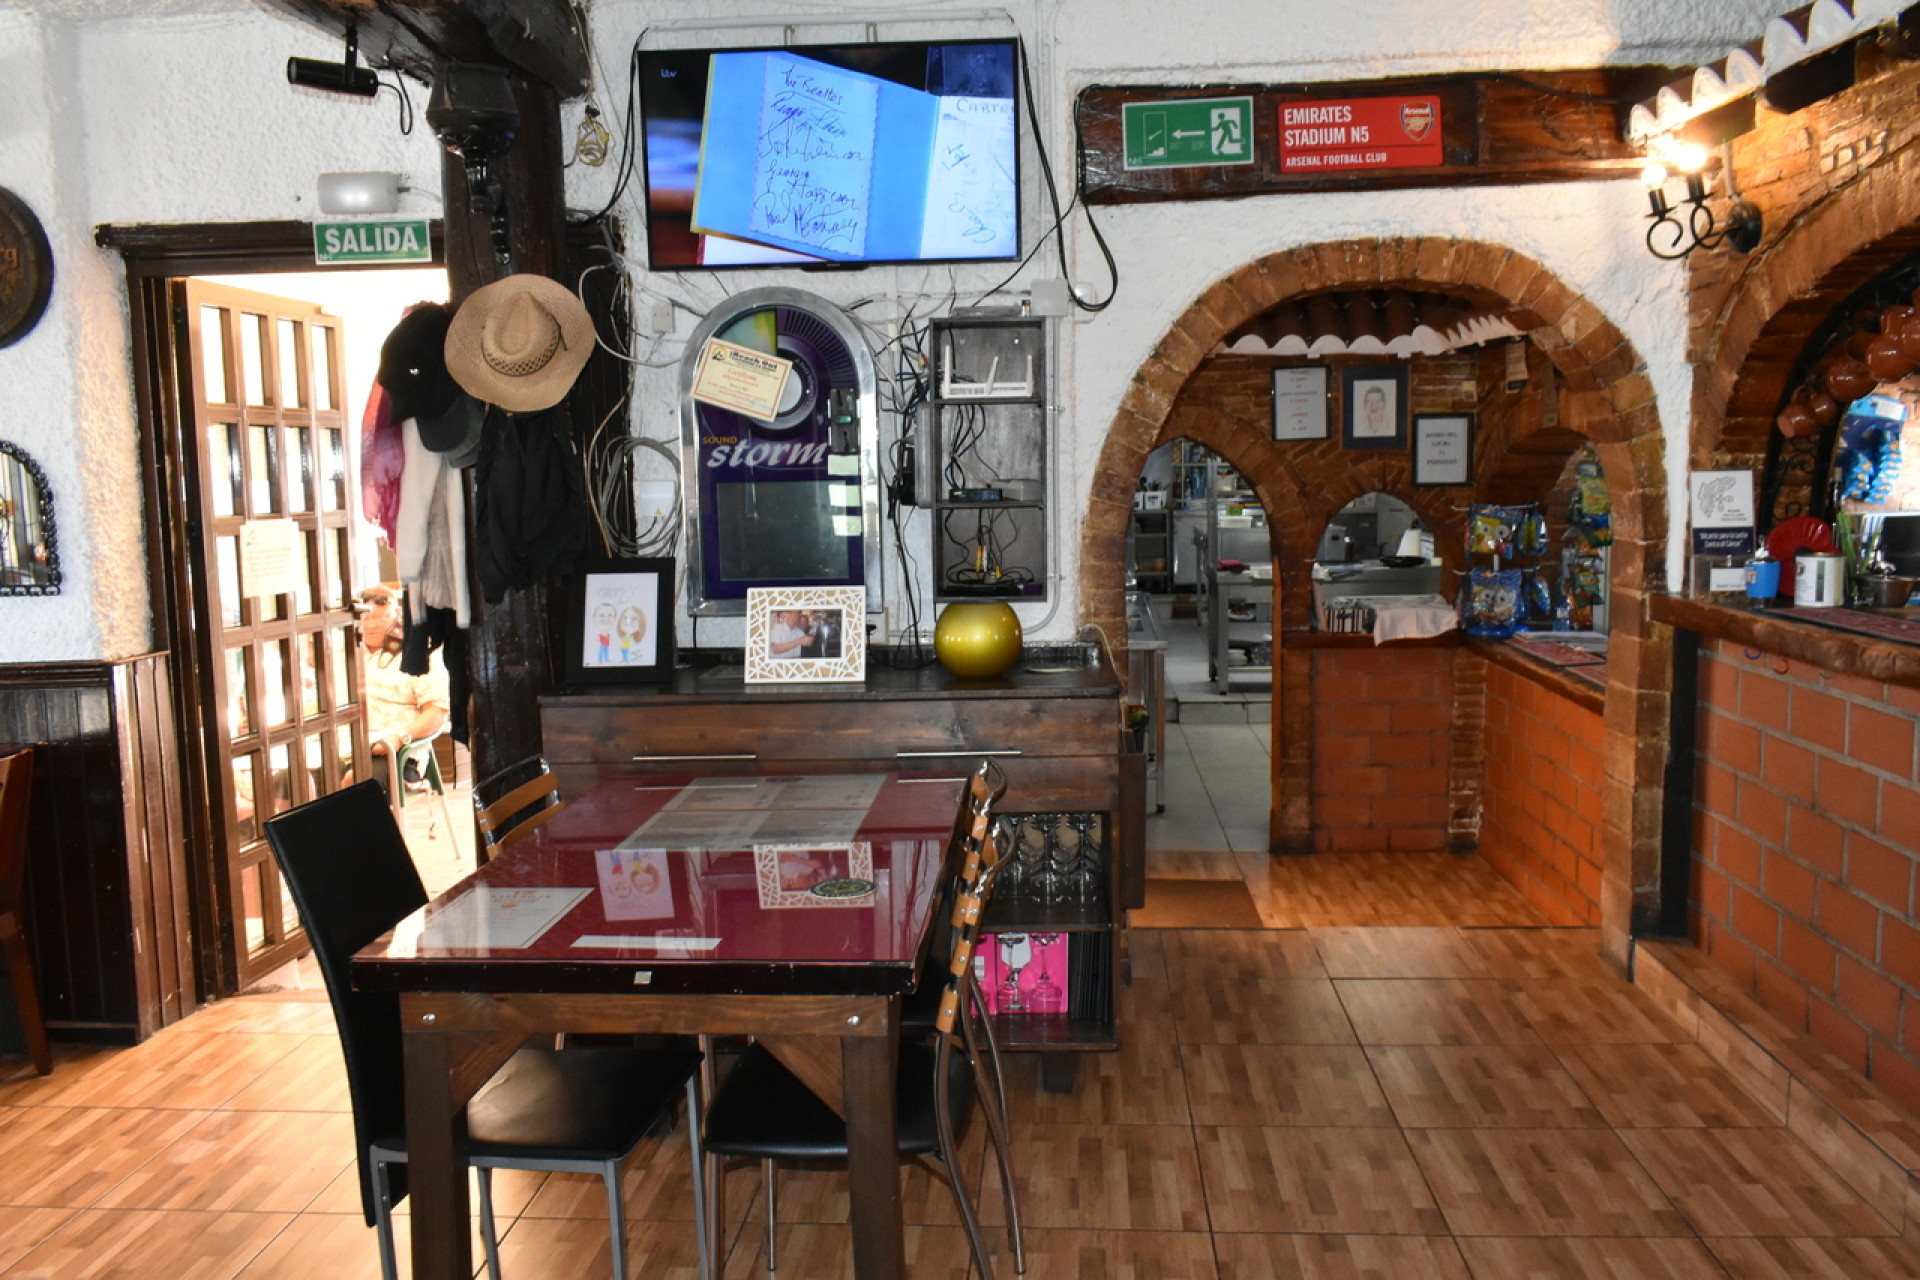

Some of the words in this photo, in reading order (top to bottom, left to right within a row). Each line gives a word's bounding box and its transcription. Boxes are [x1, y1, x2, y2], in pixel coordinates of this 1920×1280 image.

[661, 69, 677, 78] itv
[1284, 106, 1352, 125] EMIRATES
[1285, 127, 1346, 147] STADIUM
[1351, 126, 1369, 143] N5
[1286, 155, 1322, 167] ARSENAL
[1323, 153, 1363, 165] FOOTBALL
[1365, 152, 1387, 163] CLUB
[325, 226, 419, 253] SALIDA
[703, 435, 738, 444] SOUND
[707, 439, 829, 468] storm
